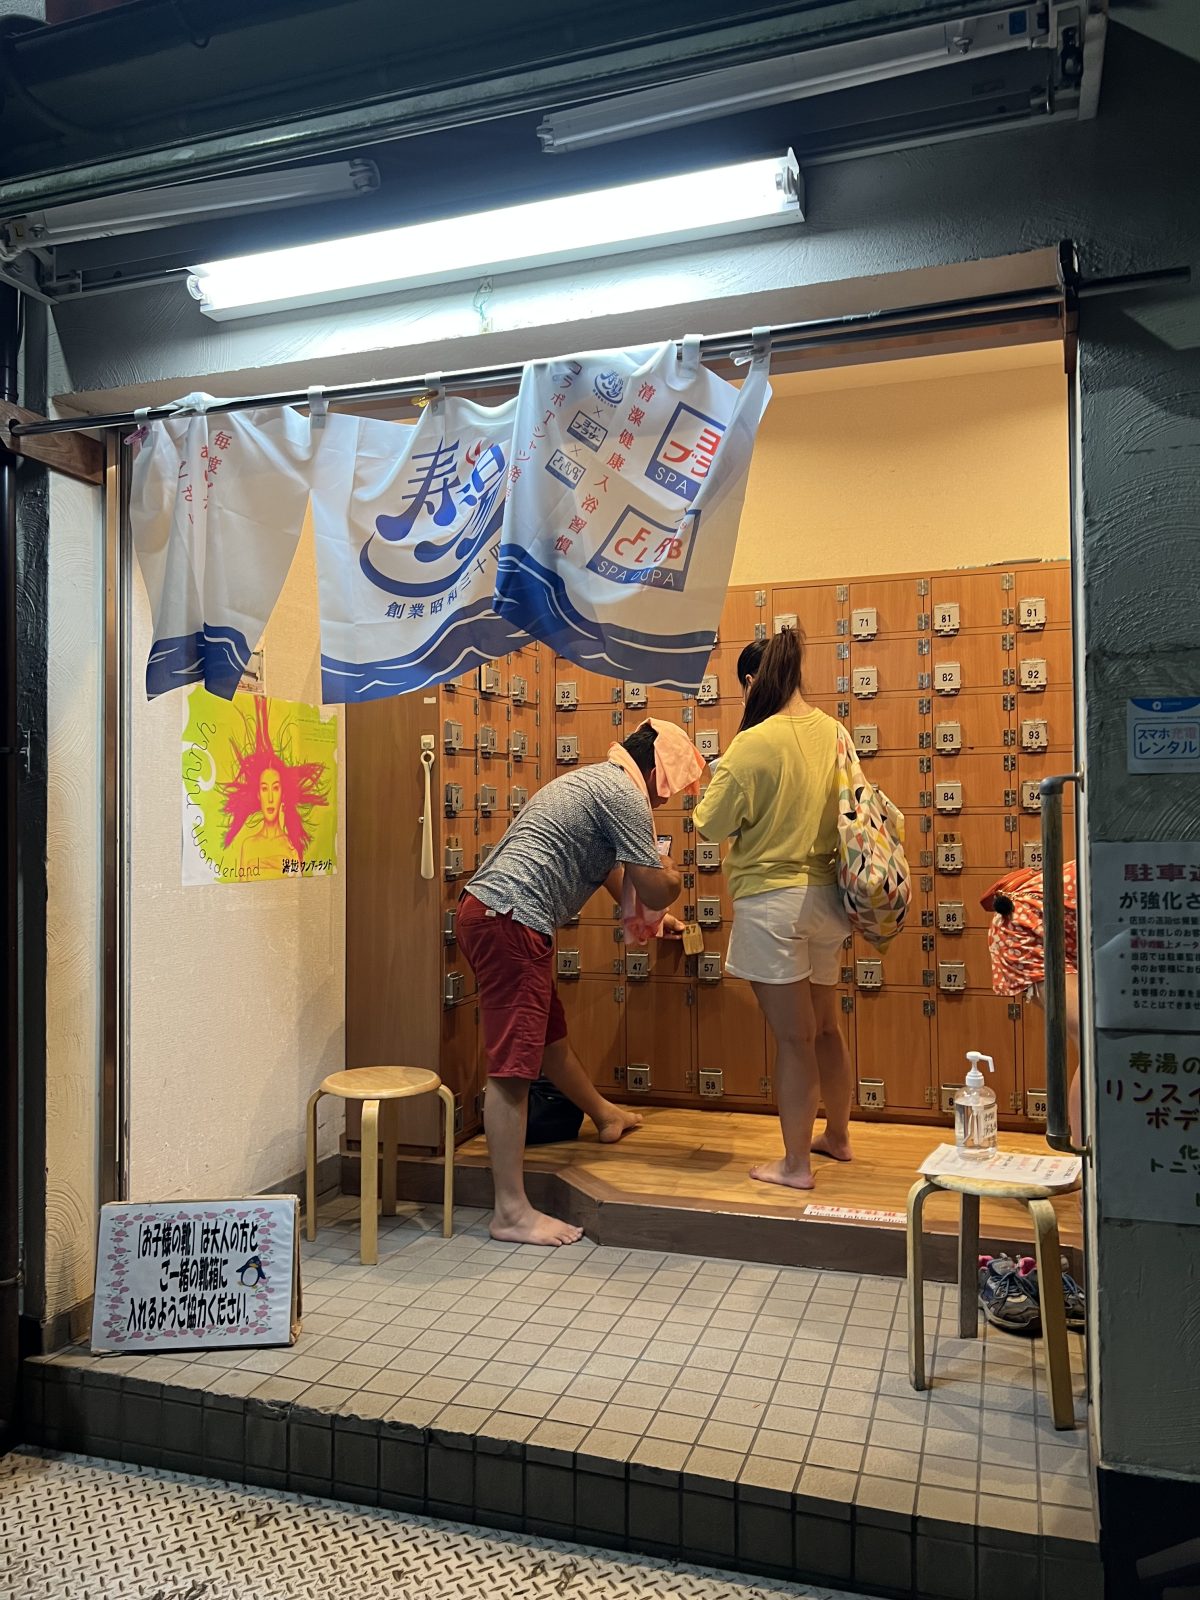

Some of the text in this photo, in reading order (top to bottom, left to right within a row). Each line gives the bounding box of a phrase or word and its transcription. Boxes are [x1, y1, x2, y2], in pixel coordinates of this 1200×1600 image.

[208, 431, 232, 475] 毎度
[554, 381, 657, 556] 清潔健康入浴習慣
[655, 467, 688, 494] SPA
[597, 561, 627, 581] SPA
[1026, 608, 1038, 618] 91
[859, 618, 869, 627] 71
[941, 614, 951, 623] 81
[942, 672, 953, 682] 82
[1027, 670, 1039, 679] 92
[860, 676, 871, 686] 72
[630, 687, 640, 697] 42
[701, 684, 711, 693] 52
[561, 690, 570, 699] 32
[860, 735, 871, 744] 73
[942, 733, 954, 743] 83
[1028, 730, 1040, 740] 93
[561, 744, 571, 753] 33
[702, 740, 712, 749] 53
[1139, 740, 1197, 755] レンタル
[943, 792, 954, 801] 84
[1029, 792, 1041, 801] 94
[703, 851, 713, 860] 55
[944, 853, 955, 862] 85
[1031, 853, 1042, 862] 95
[703, 908, 713, 916] 56
[946, 913, 957, 922] 86
[685, 925, 697, 935] 57
[563, 960, 572, 968] 37
[632, 963, 642, 972] 47
[704, 963, 713, 972] 57
[863, 971, 873, 980] 77
[947, 973, 958, 983] 87
[633, 1076, 643, 1086] 48
[706, 1081, 716, 1090] 58
[866, 1092, 877, 1101] 78
[1034, 1102, 1047, 1112] 98
[160, 1257, 229, 1292] ご一緒の靴箱に
[127, 1293, 250, 1332] 入れるようご協力ください。
